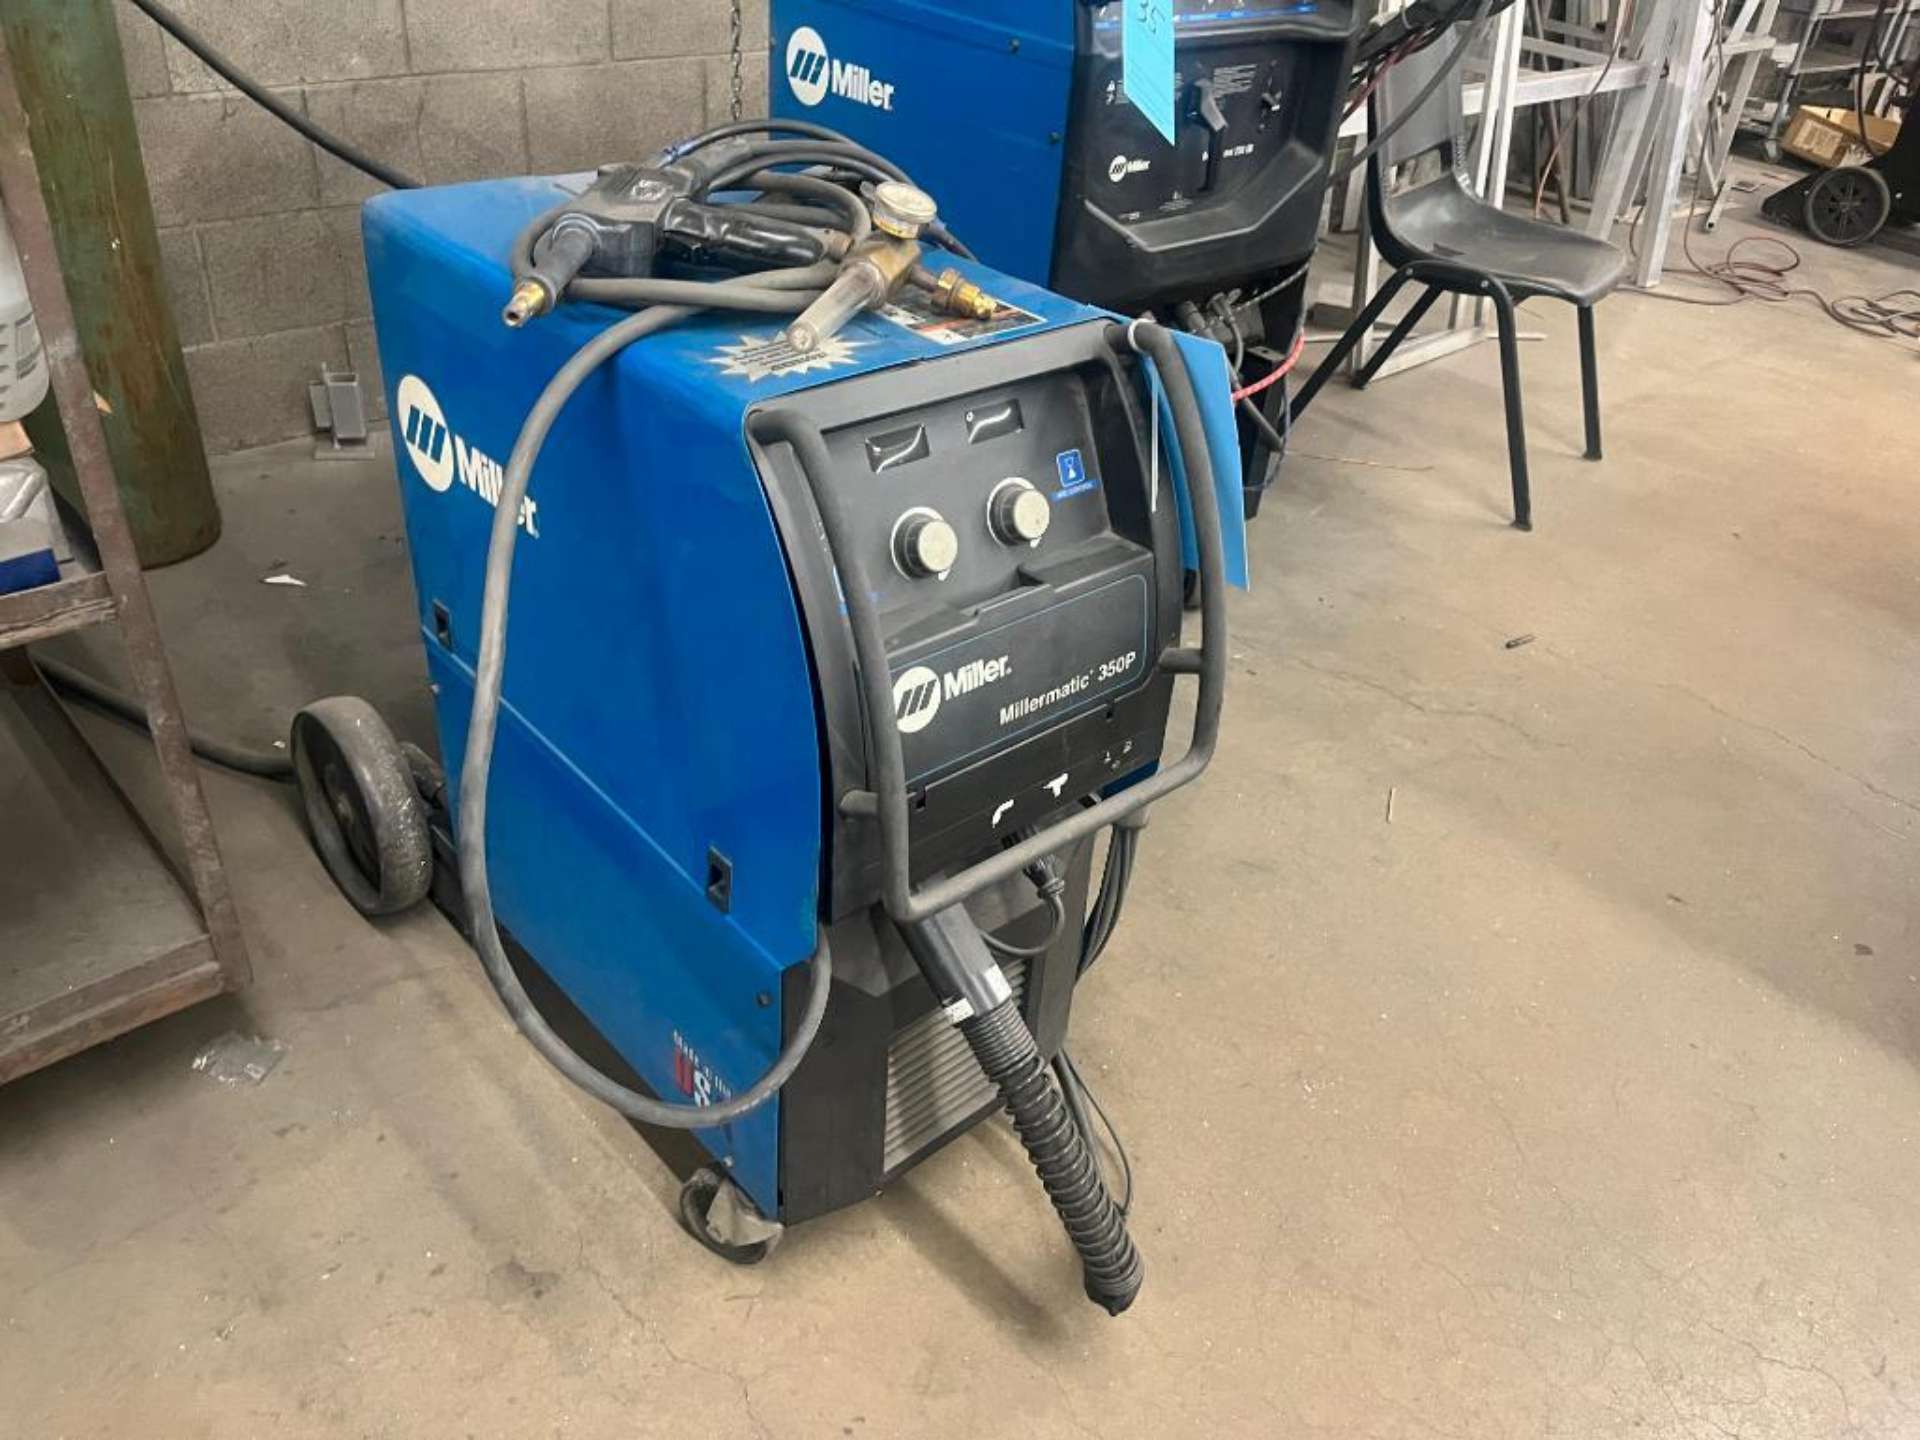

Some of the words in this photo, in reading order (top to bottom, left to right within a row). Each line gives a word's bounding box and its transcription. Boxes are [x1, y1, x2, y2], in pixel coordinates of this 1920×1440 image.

[831, 58, 895, 111] Miller
[943, 655, 1011, 701] Miller
[999, 671, 1091, 726] Millermatic
[1097, 650, 1136, 682] 350P
